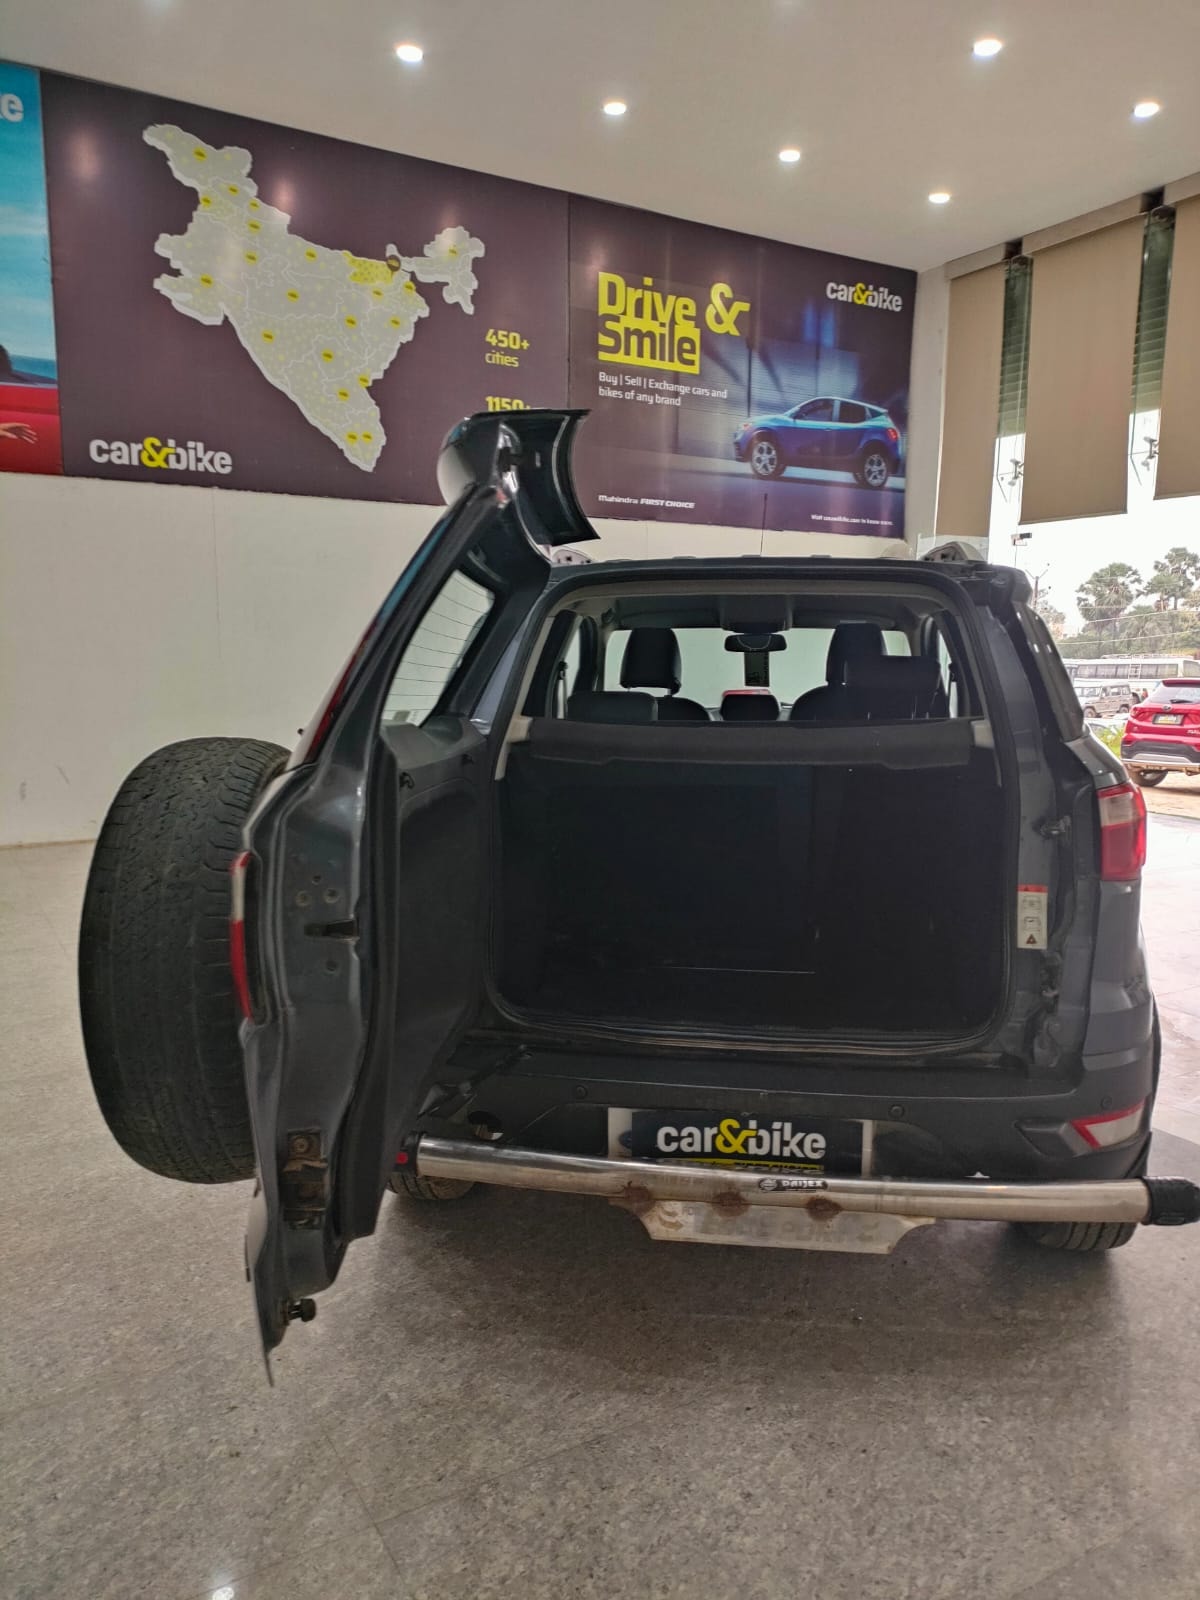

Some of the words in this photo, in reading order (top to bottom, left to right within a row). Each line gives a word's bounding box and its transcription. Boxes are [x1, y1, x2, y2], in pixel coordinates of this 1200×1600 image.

[598, 271, 697, 328] Drive
[705, 282, 751, 337] &
[826, 282, 903, 312] car&bike
[485, 328, 530, 350] 450+
[598, 313, 697, 366] Smile
[485, 349, 520, 367] cities
[598, 371, 618, 386] Buy
[624, 375, 642, 387] Sell
[648, 378, 691, 395] Exchange
[691, 386, 710, 396] cars
[711, 389, 728, 399] and
[598, 386, 623, 399] bikes
[624, 389, 636, 400] of
[636, 393, 654, 405] any
[655, 393, 682, 406] brand
[89, 436, 233, 475] car&bike
[598, 494, 639, 504] Mahindra
[639, 498, 665, 507] FIRST
[665, 500, 696, 509] CHOICE
[656, 1117, 827, 1160] car&bike
